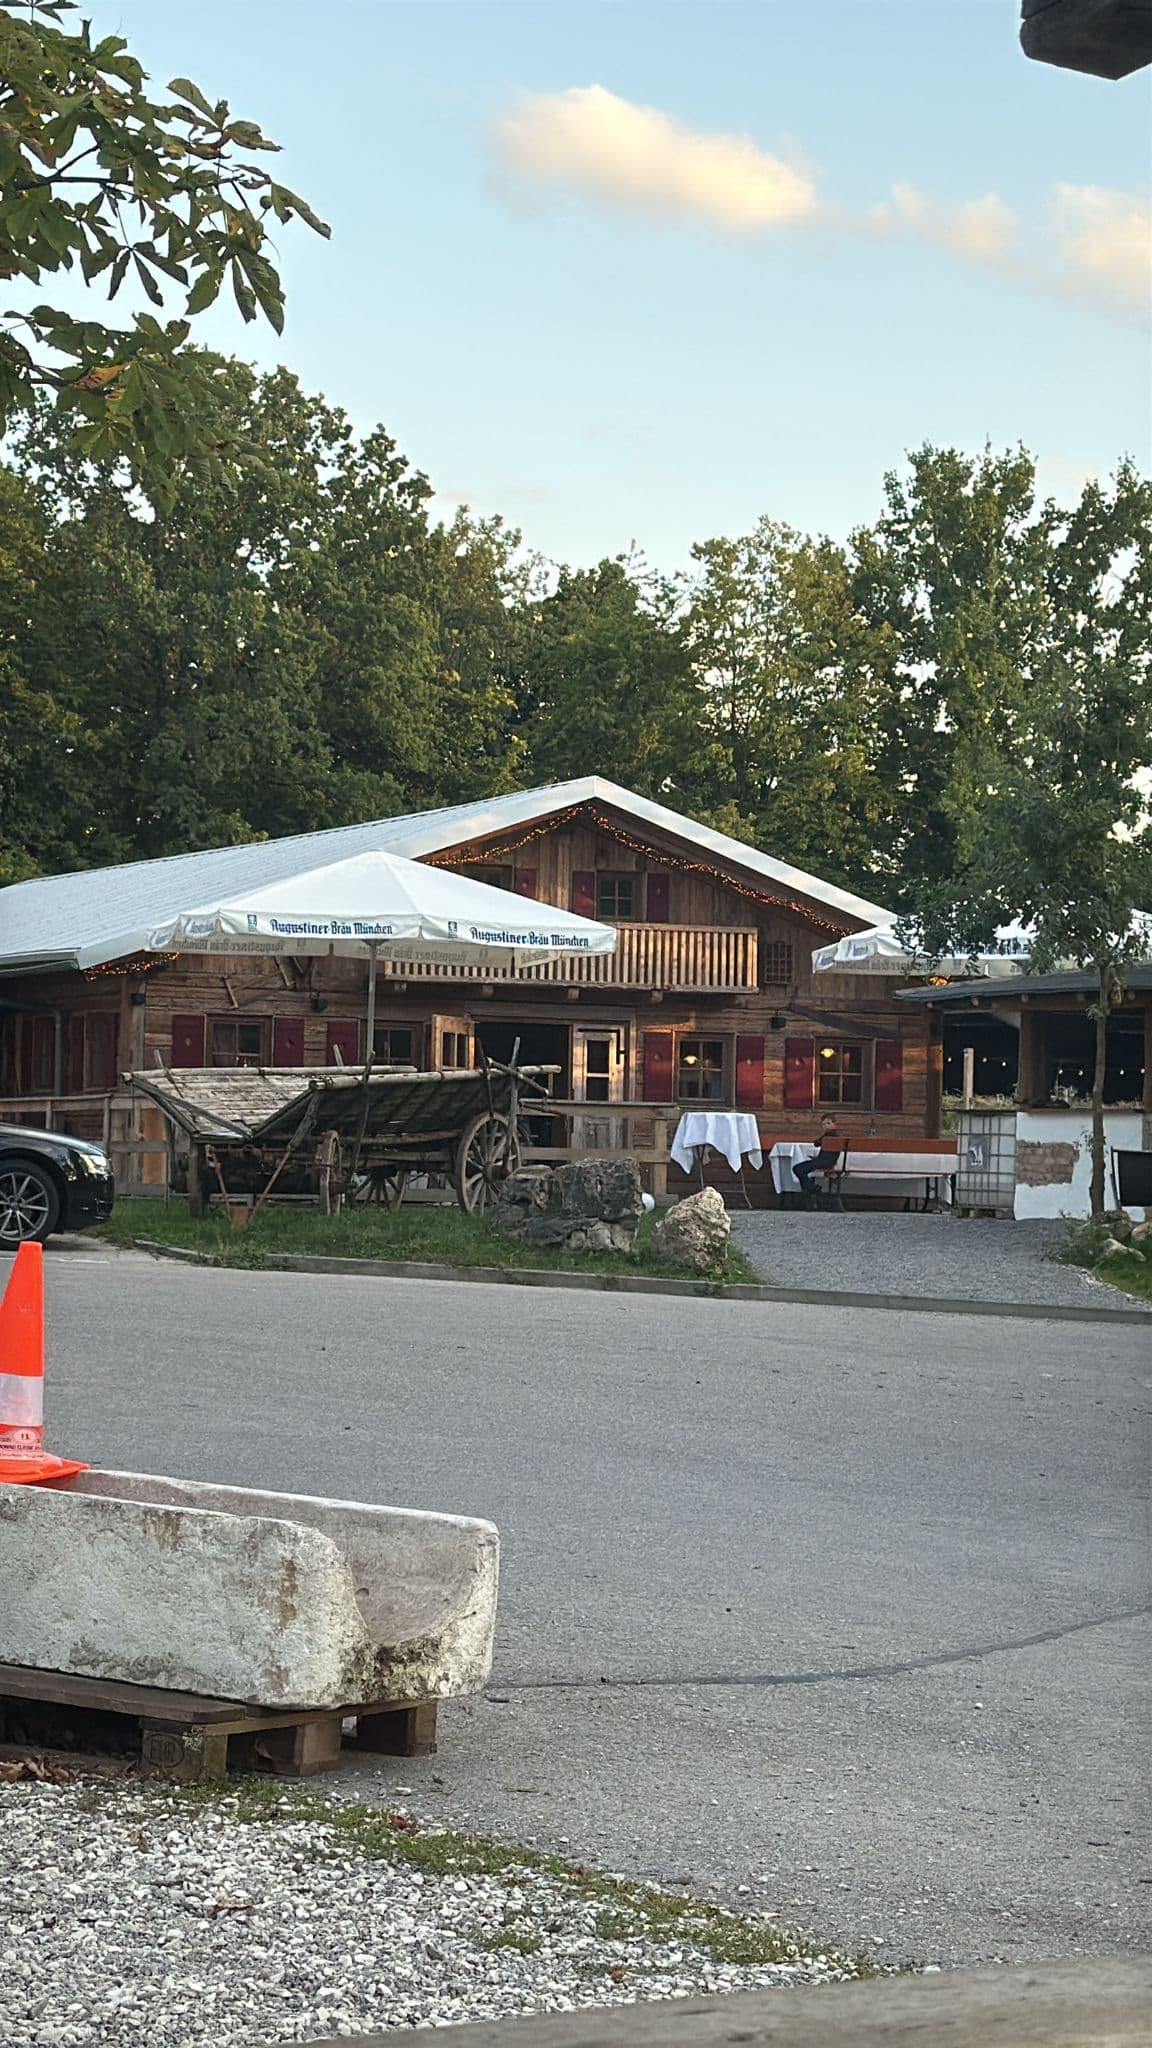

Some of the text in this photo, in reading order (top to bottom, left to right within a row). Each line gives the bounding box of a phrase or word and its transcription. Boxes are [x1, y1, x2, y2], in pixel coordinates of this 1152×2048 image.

[353, 922, 393, 935] München
[550, 934, 589, 948] München
[150, 1739, 176, 1763] EUR
